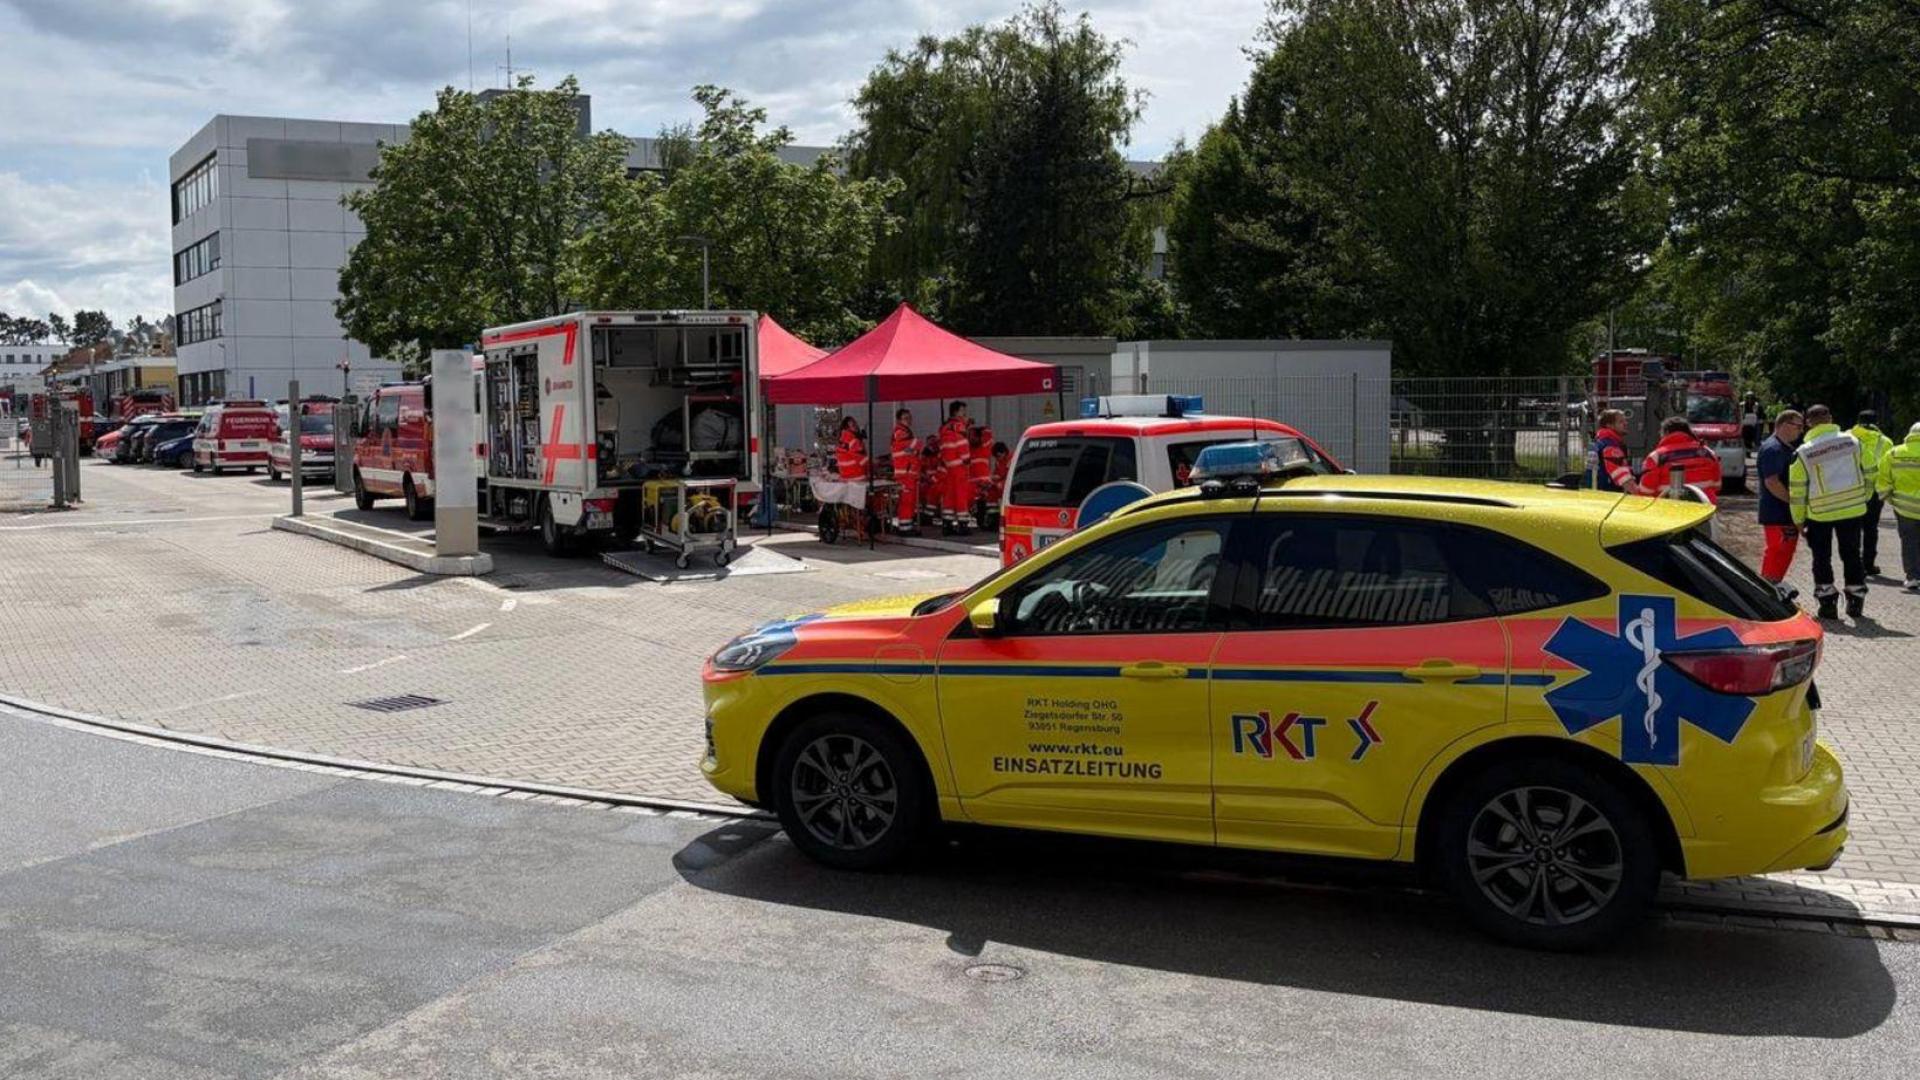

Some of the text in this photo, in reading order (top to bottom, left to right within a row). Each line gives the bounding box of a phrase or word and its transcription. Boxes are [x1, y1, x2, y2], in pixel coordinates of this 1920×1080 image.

[1027, 698, 1118, 710] RKT Holding OHG
[1091, 712, 1107, 721] Str.
[1060, 723, 1121, 734] Regensburg
[1231, 710, 1327, 760] RKT
[1028, 742, 1124, 756] www.rkt.eu
[993, 757, 1163, 779] EINSATZLEITUNG
